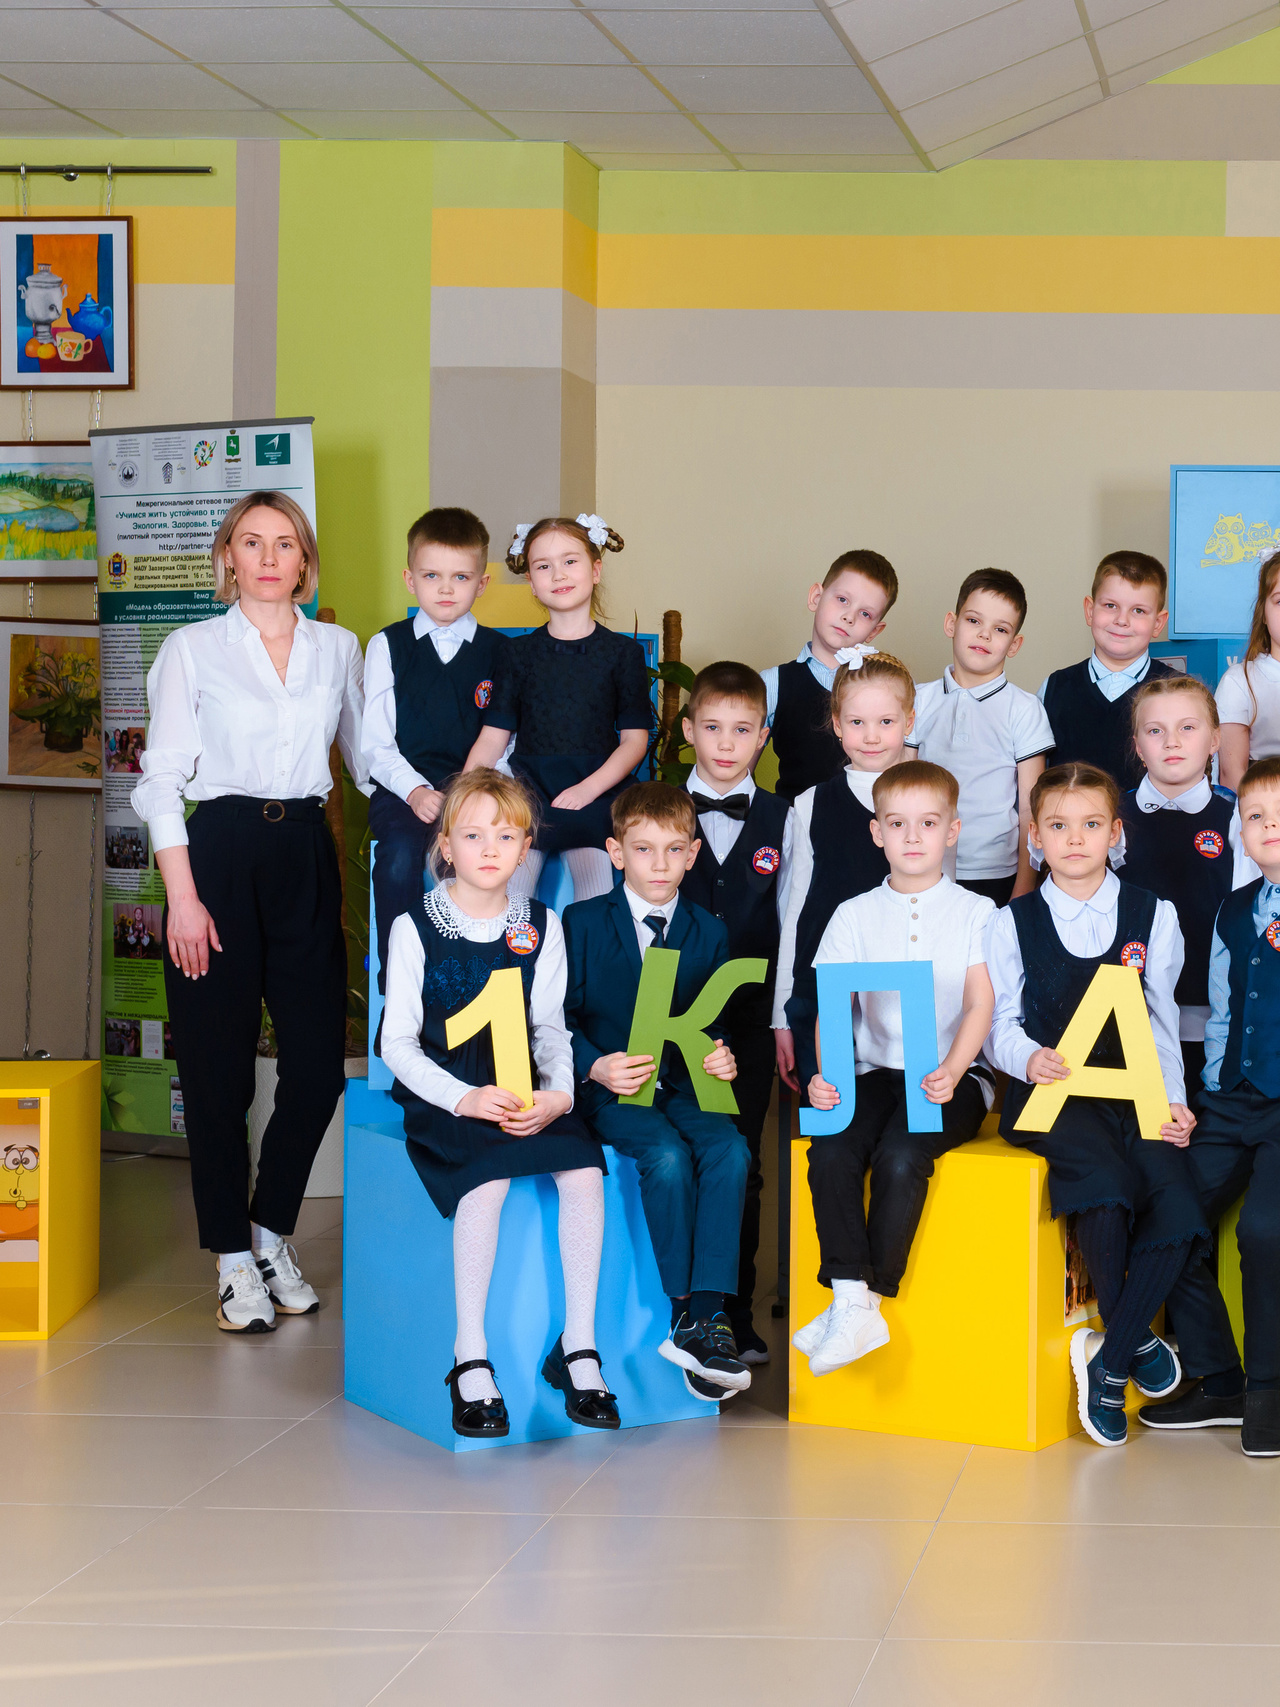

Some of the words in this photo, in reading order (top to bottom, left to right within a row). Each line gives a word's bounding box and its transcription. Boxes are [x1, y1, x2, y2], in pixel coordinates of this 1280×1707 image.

[169, 508, 208, 518] устойчиво
[211, 519, 222, 527] Бе
[151, 532, 174, 540] проект
[193, 591, 210, 600] Тема
[445, 967, 534, 1113] 1
